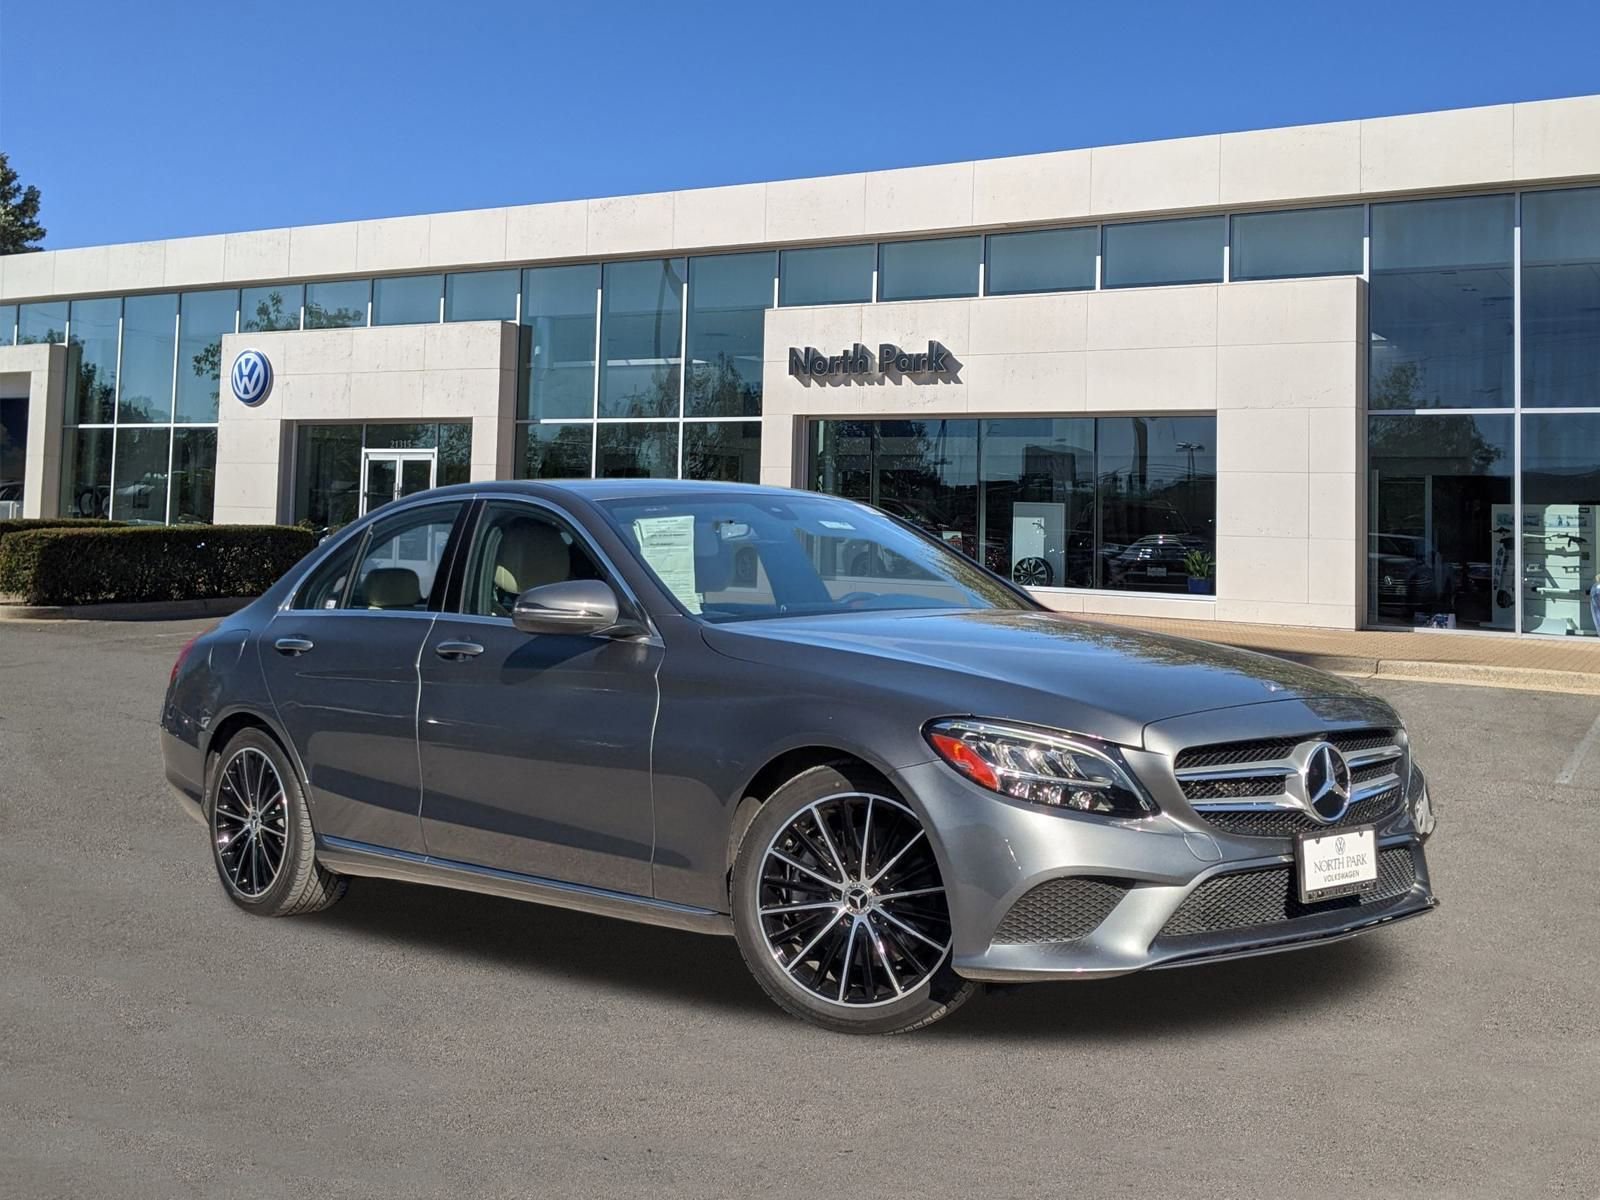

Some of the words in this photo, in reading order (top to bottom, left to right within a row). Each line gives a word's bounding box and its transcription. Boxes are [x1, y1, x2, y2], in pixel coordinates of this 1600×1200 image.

[788, 343, 870, 375] North
[878, 340, 947, 374] Park
[390, 439, 412, 449] 21315
[1314, 857, 1345, 873] NORTH
[1346, 854, 1367, 867] PARK
[1324, 871, 1359, 882] VOLKSWAGEN
